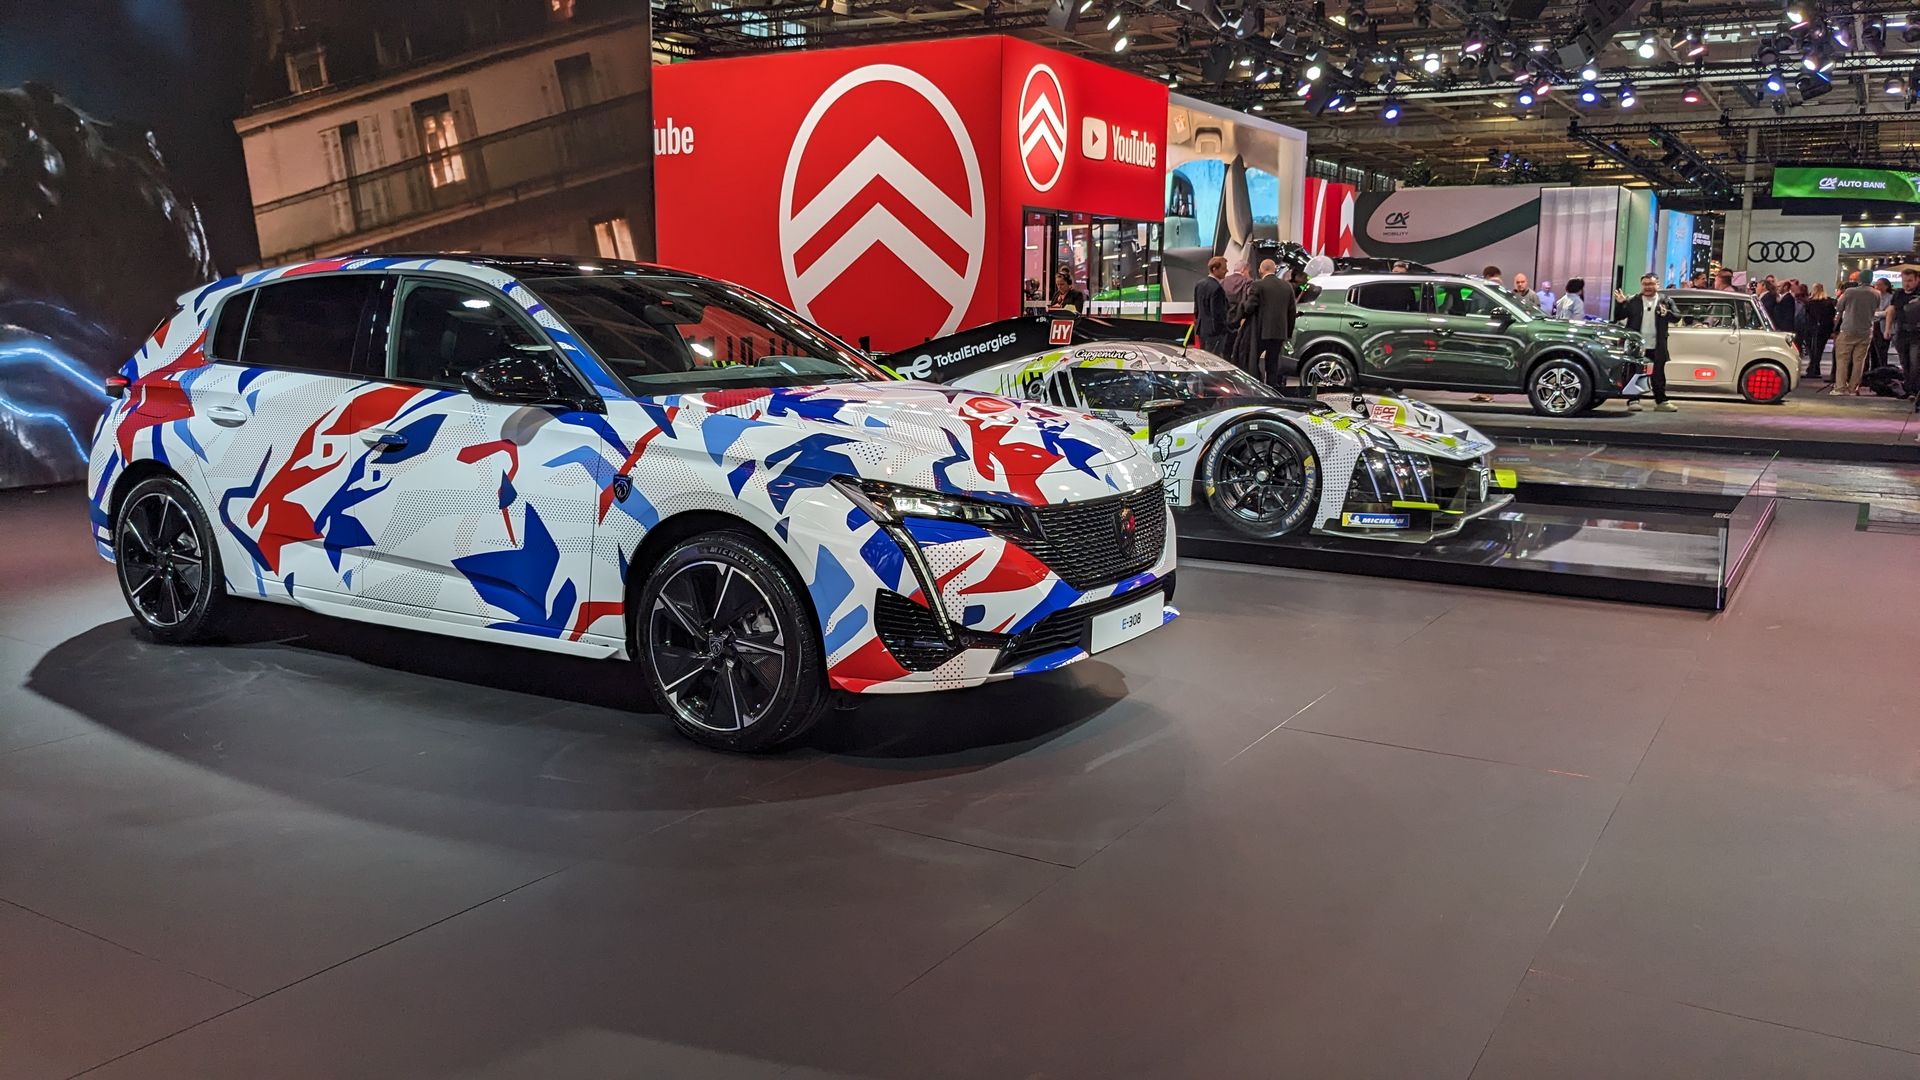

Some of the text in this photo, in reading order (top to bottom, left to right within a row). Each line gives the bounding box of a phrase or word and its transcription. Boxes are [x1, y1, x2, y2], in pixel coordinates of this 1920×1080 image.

[654, 117, 694, 155] ube
[1112, 125, 1156, 168] YouTube
[1838, 180, 1862, 188] AUTO
[1863, 181, 1886, 189] BANK
[1839, 232, 1865, 248] RA
[1052, 324, 1073, 340] HY
[934, 332, 1017, 367] TotalEnergies
[1075, 349, 1126, 361] Capgemini
[1206, 429, 1232, 477] MICHELIN
[1285, 477, 1314, 525] MICHELIN
[710, 547, 757, 571] MICHELIN
[1121, 612, 1142, 630] E-308
